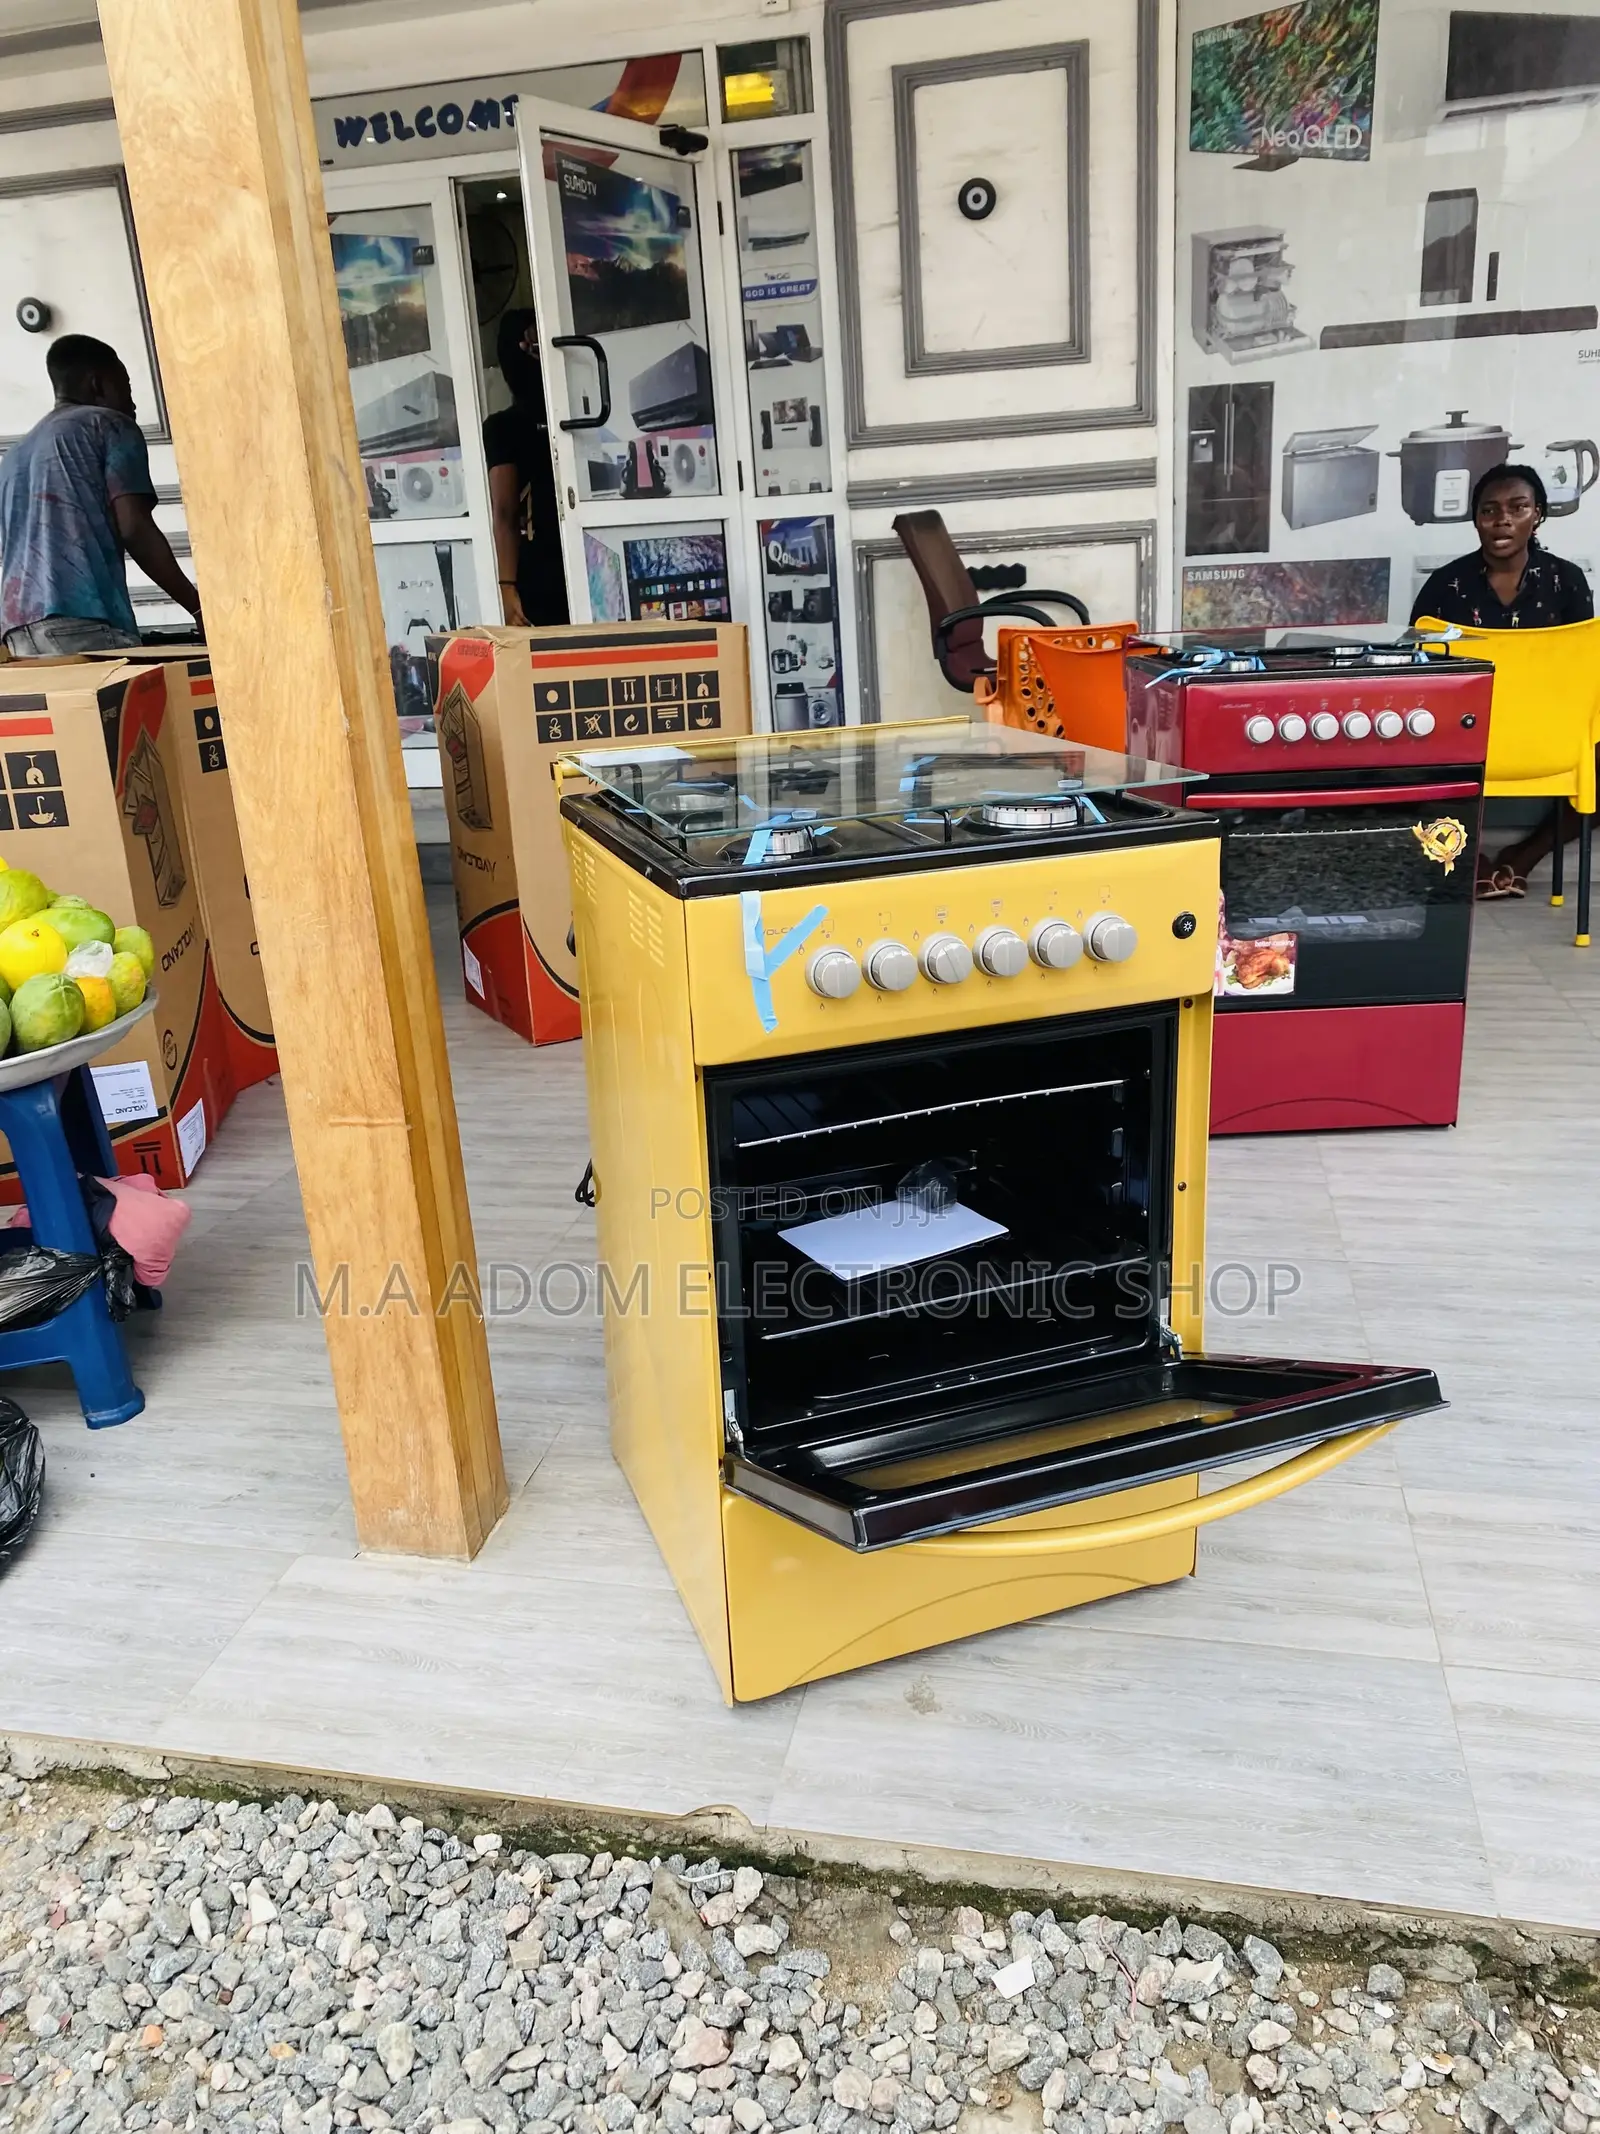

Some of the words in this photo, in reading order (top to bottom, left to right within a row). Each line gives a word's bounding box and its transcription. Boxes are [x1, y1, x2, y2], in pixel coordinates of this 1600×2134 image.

[1260, 126, 1300, 148] Neo
[1303, 124, 1363, 149] QLED
[745, 289, 765, 298] GOD
[767, 287, 777, 296] IS
[780, 283, 811, 294] GREAT
[1187, 568, 1245, 582] SAMSUNG
